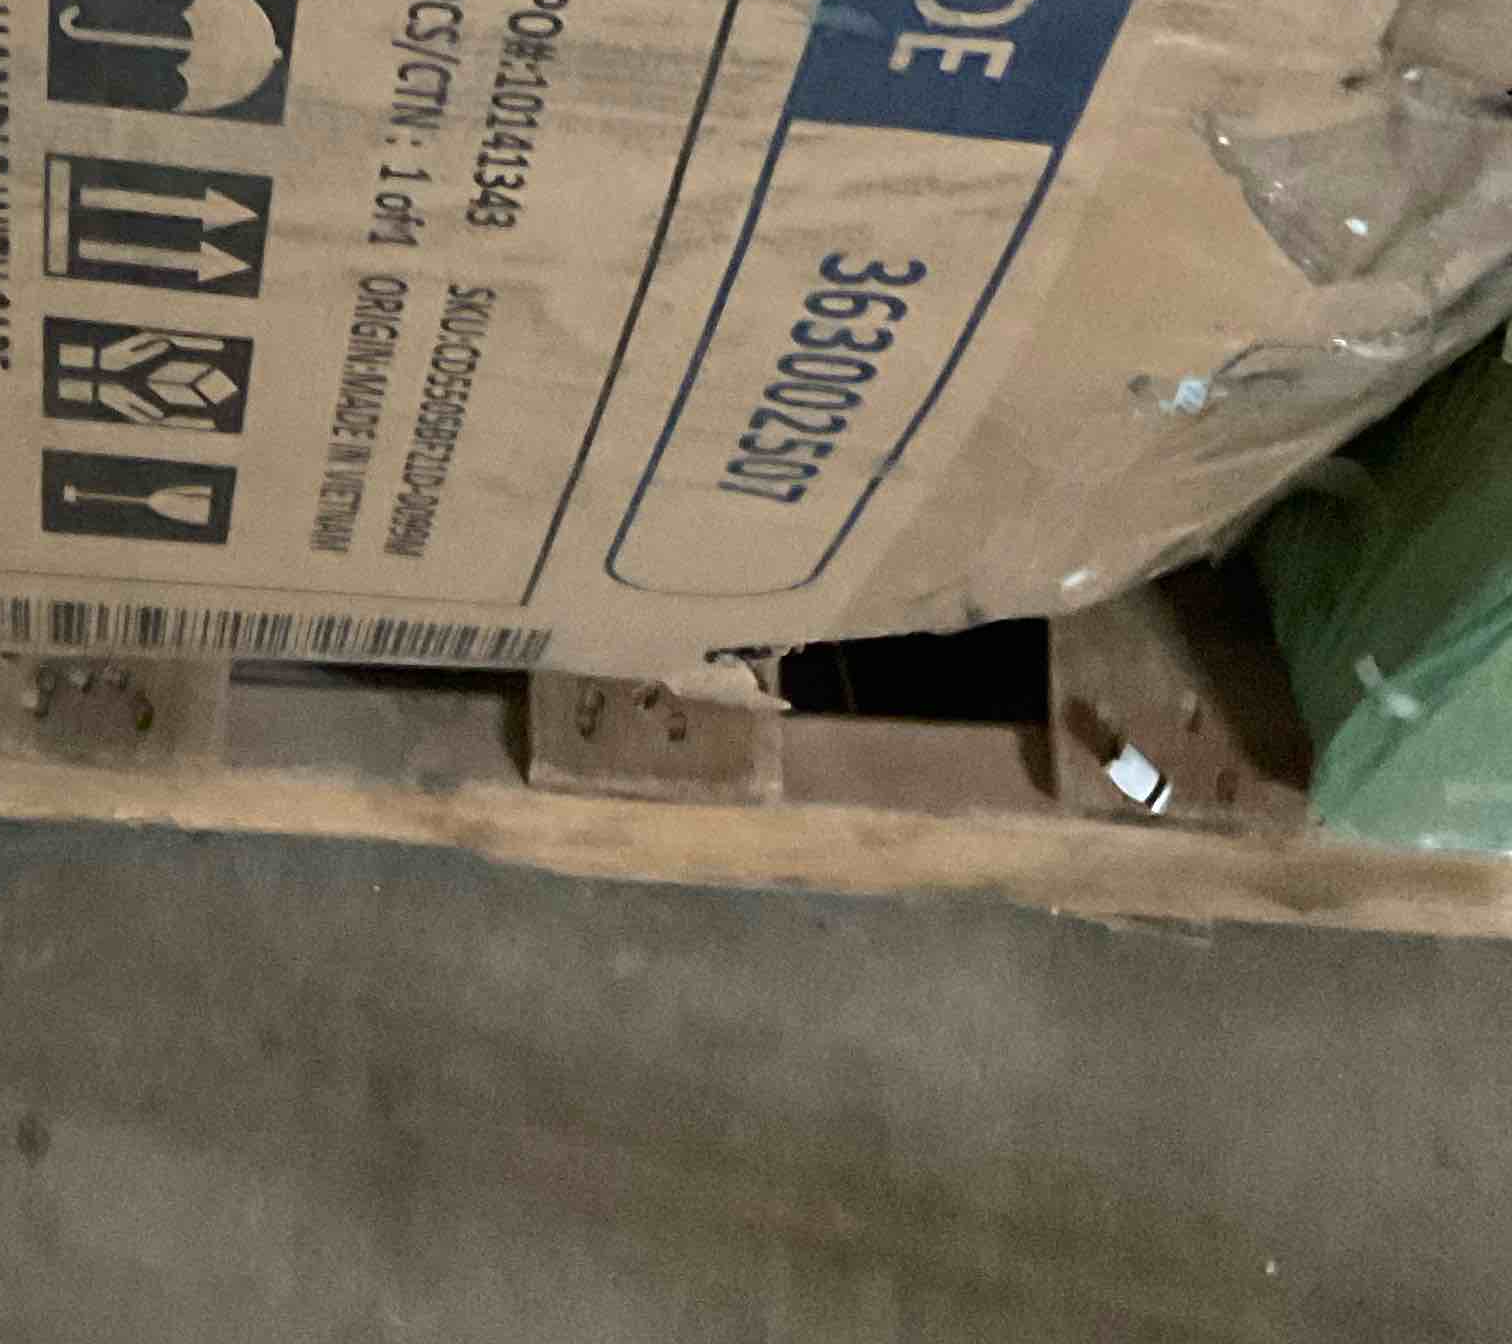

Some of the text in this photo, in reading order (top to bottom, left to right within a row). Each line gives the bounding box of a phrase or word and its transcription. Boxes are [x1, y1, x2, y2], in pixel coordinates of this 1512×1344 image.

[379, 164, 432, 183] 1
[334, 275, 409, 440] ORIGIN:MADE
[717, 250, 927, 506] 363002507
